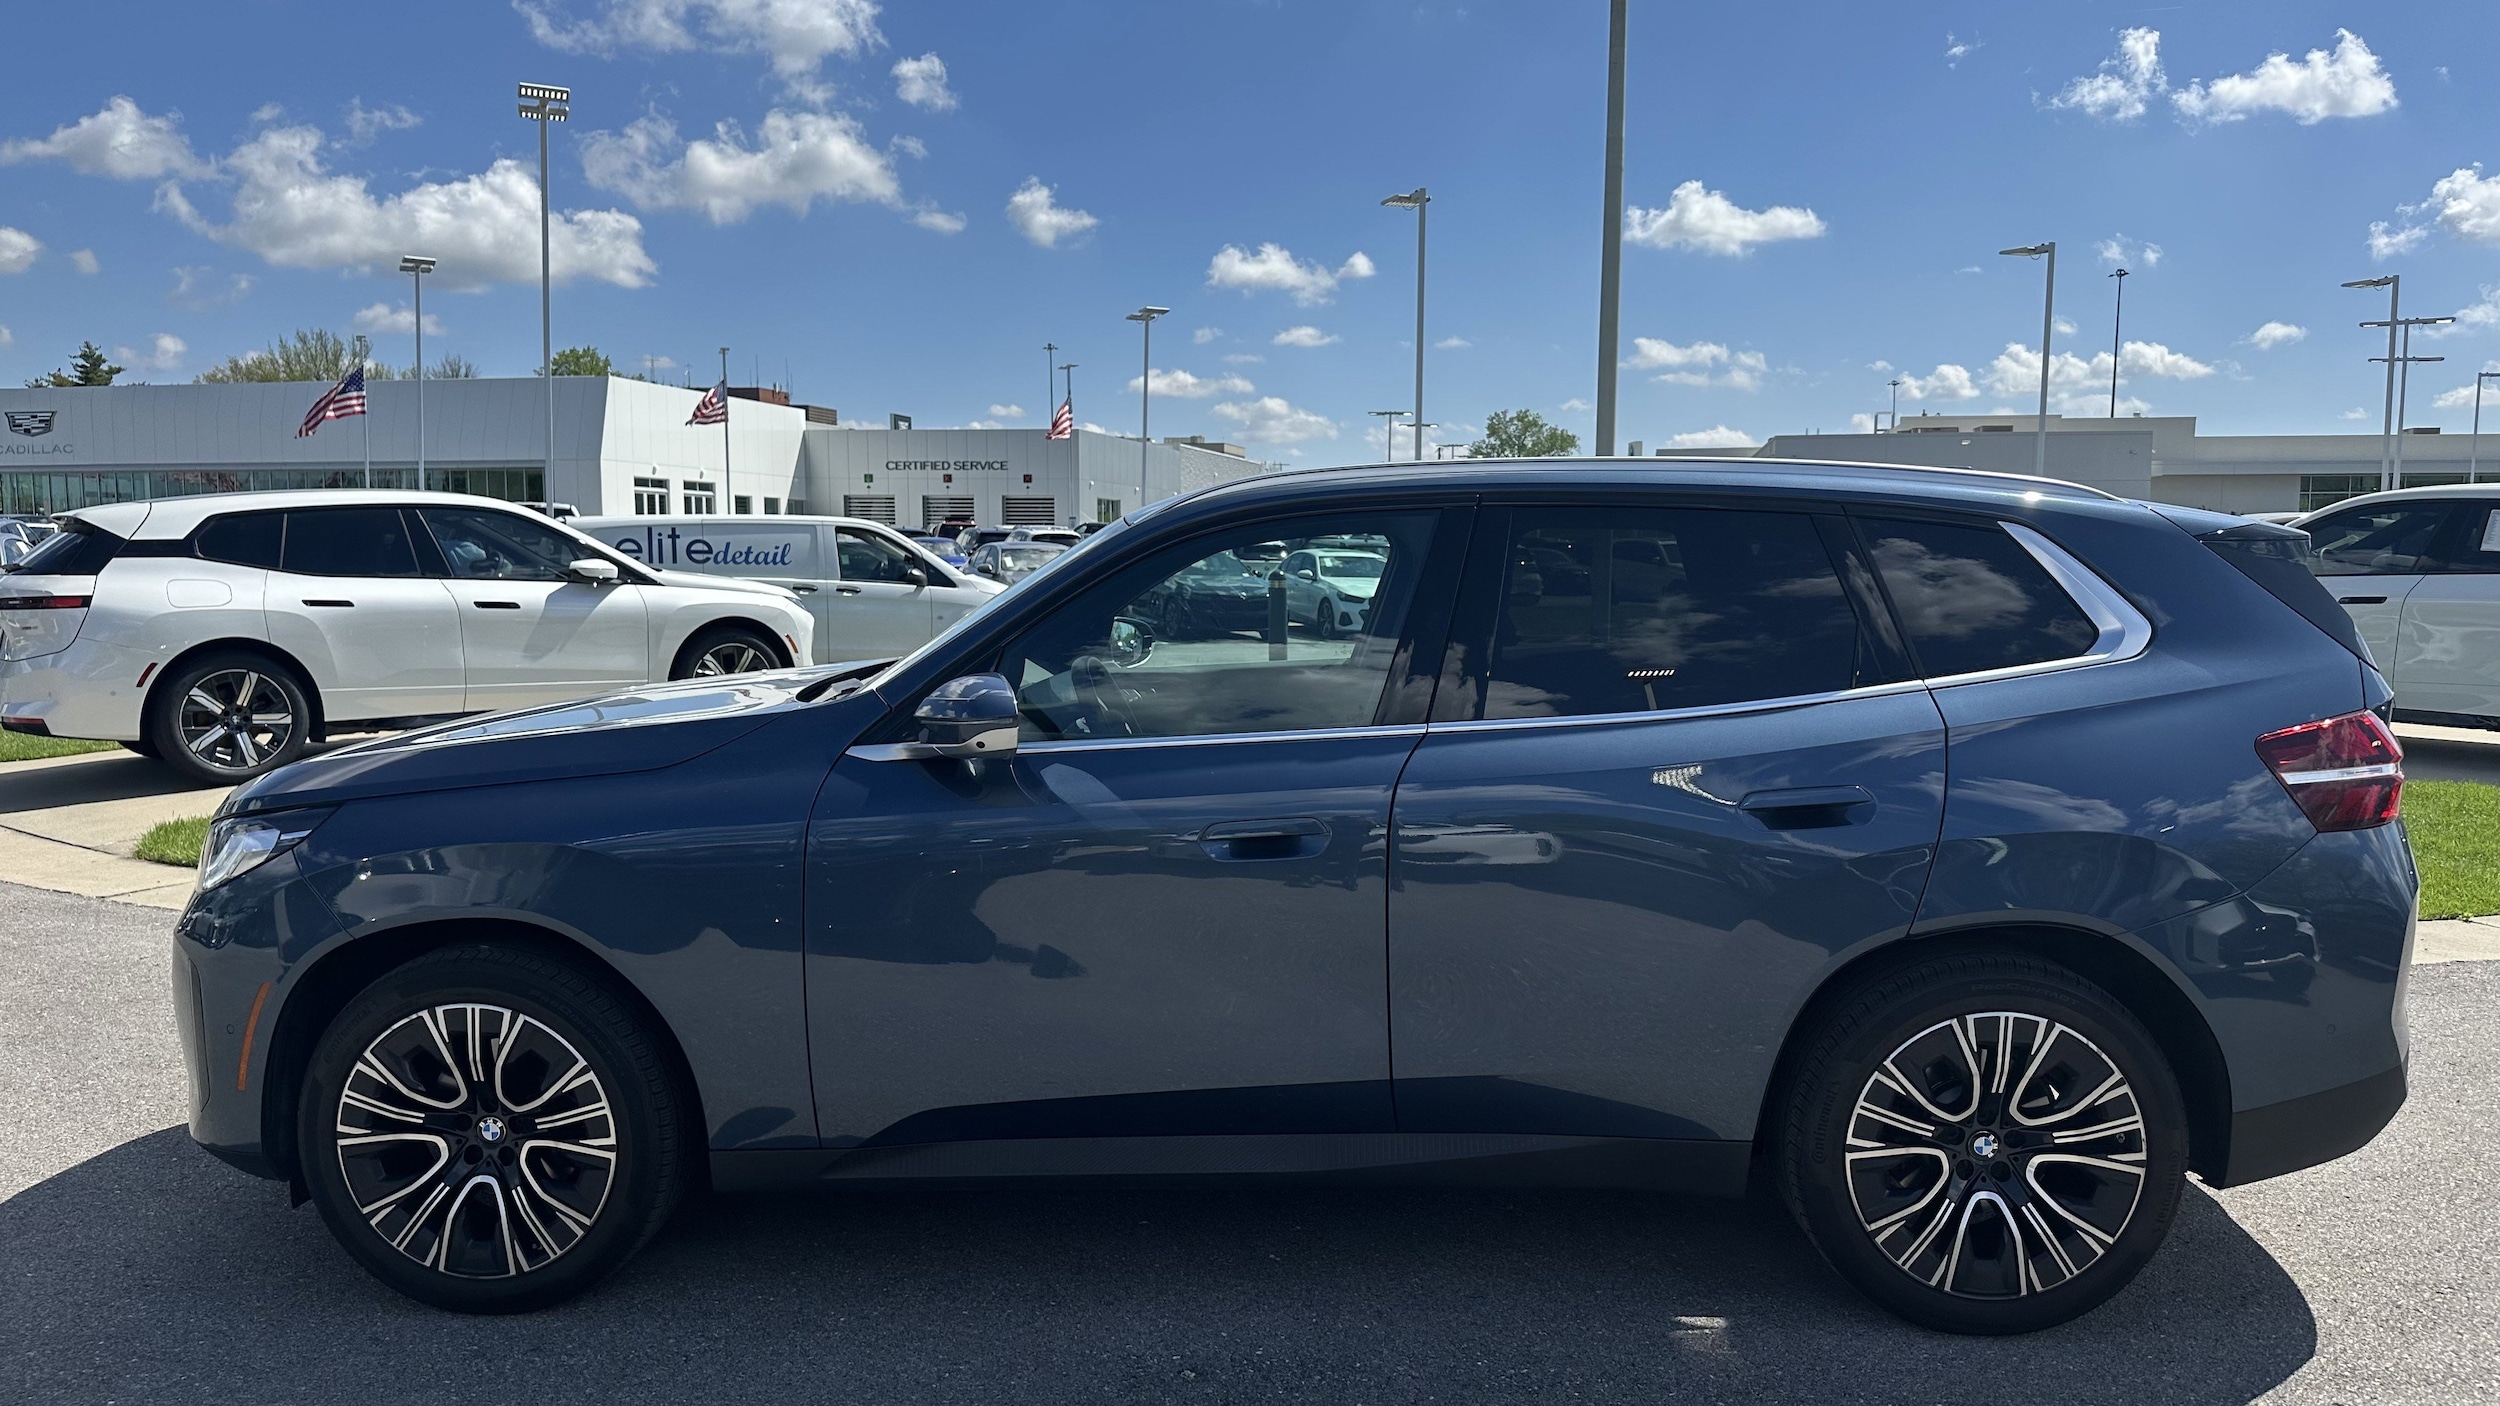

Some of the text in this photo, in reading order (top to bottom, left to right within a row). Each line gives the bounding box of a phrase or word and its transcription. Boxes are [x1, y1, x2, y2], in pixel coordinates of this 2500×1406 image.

[885, 460, 1009, 471] CERTIFIED SERVICE
[614, 526, 792, 566] elite detail
